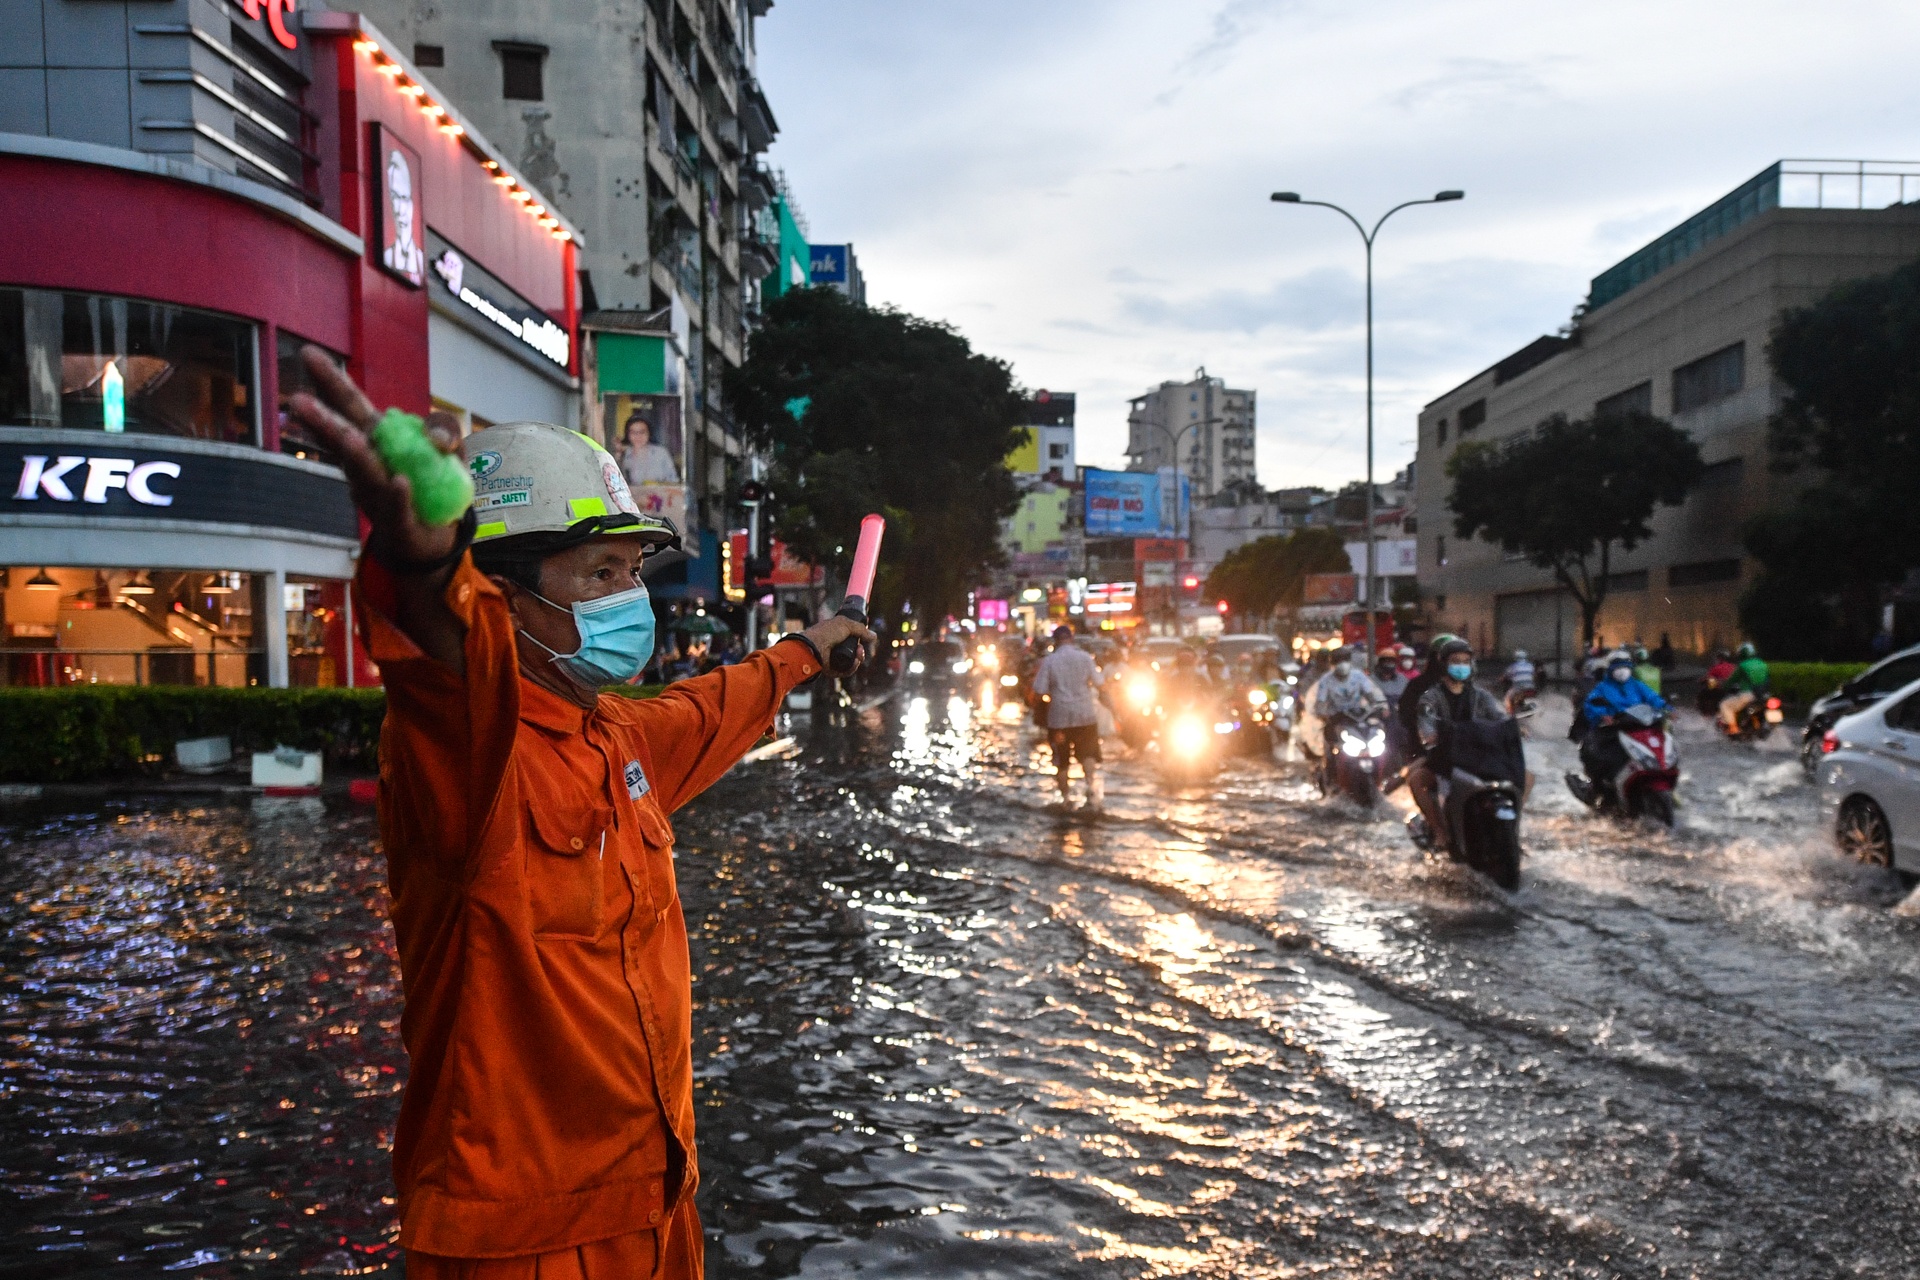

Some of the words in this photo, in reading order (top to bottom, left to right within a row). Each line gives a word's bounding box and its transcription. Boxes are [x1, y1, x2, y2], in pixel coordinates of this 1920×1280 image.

[810, 253, 837, 273] nk
[12, 455, 181, 506] KFC
[482, 475, 534, 490] Partnership
[474, 496, 490, 508] AUTY
[502, 492, 527, 504] SAFETY
